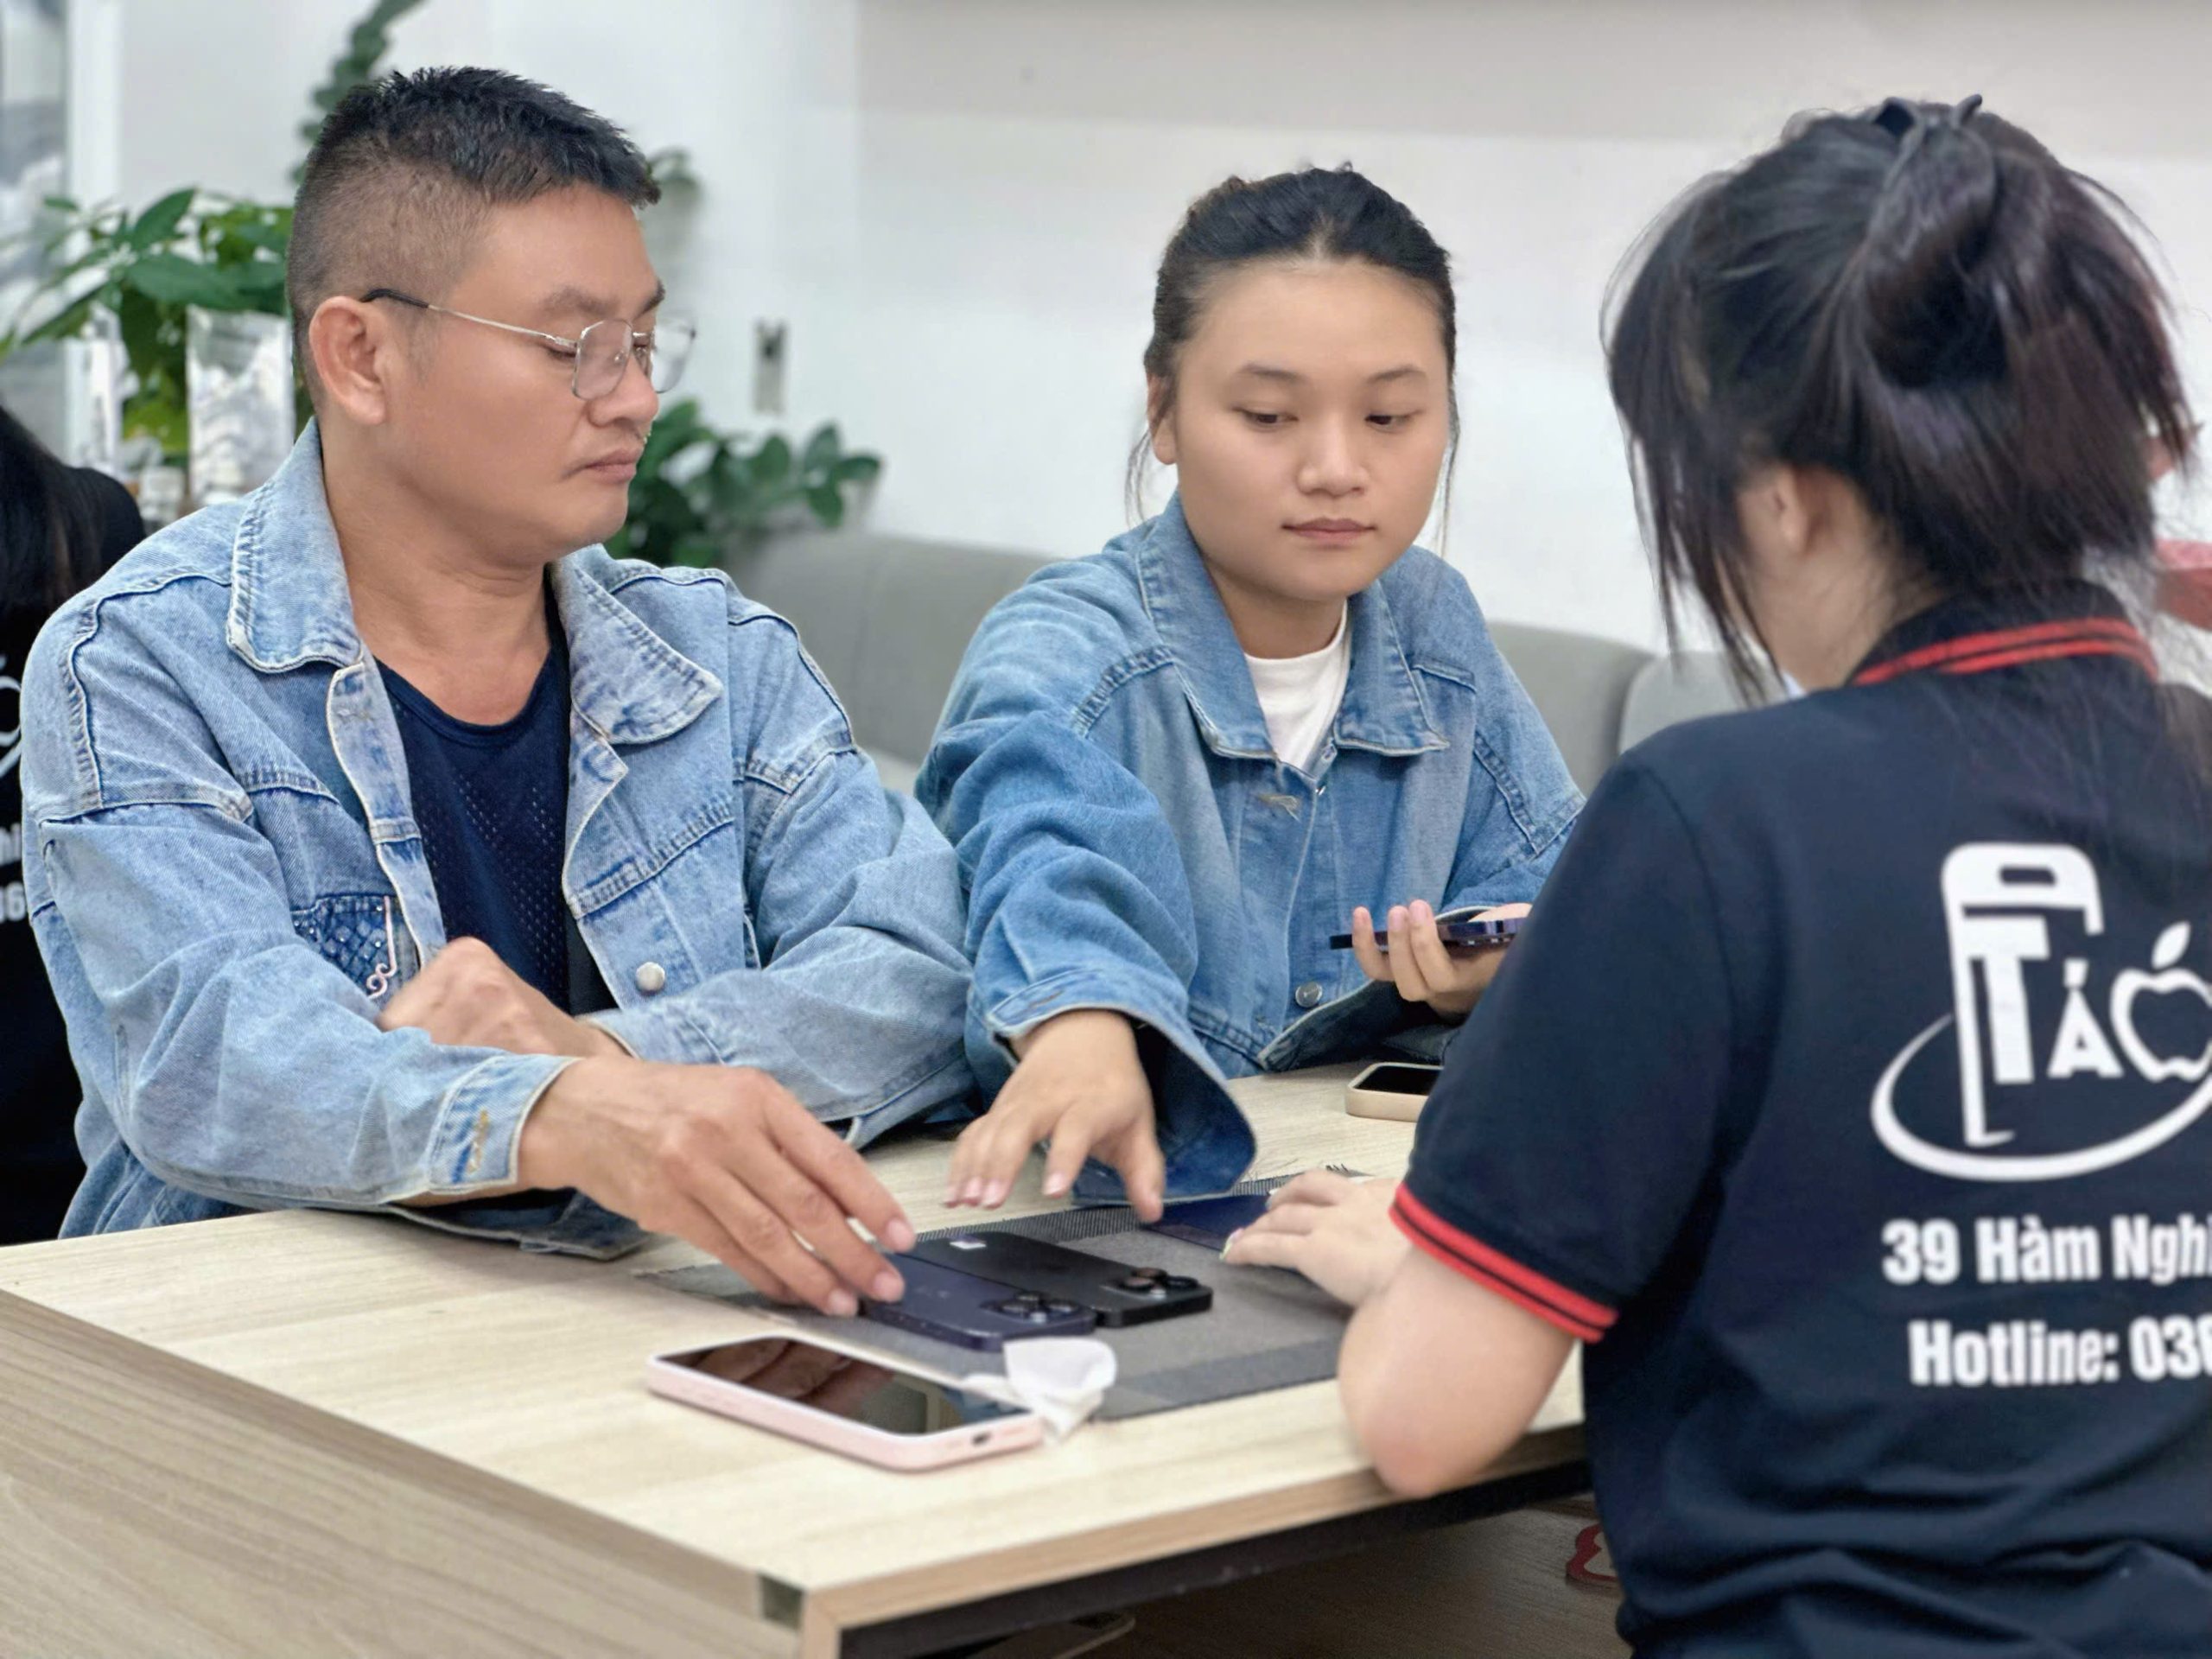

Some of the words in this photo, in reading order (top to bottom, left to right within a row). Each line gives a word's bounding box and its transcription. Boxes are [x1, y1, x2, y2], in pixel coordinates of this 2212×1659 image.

[1882, 1218, 1961, 1284] 39
[1975, 1215, 2101, 1282] Hàm
[1908, 1320, 2120, 1386] Hotline:
